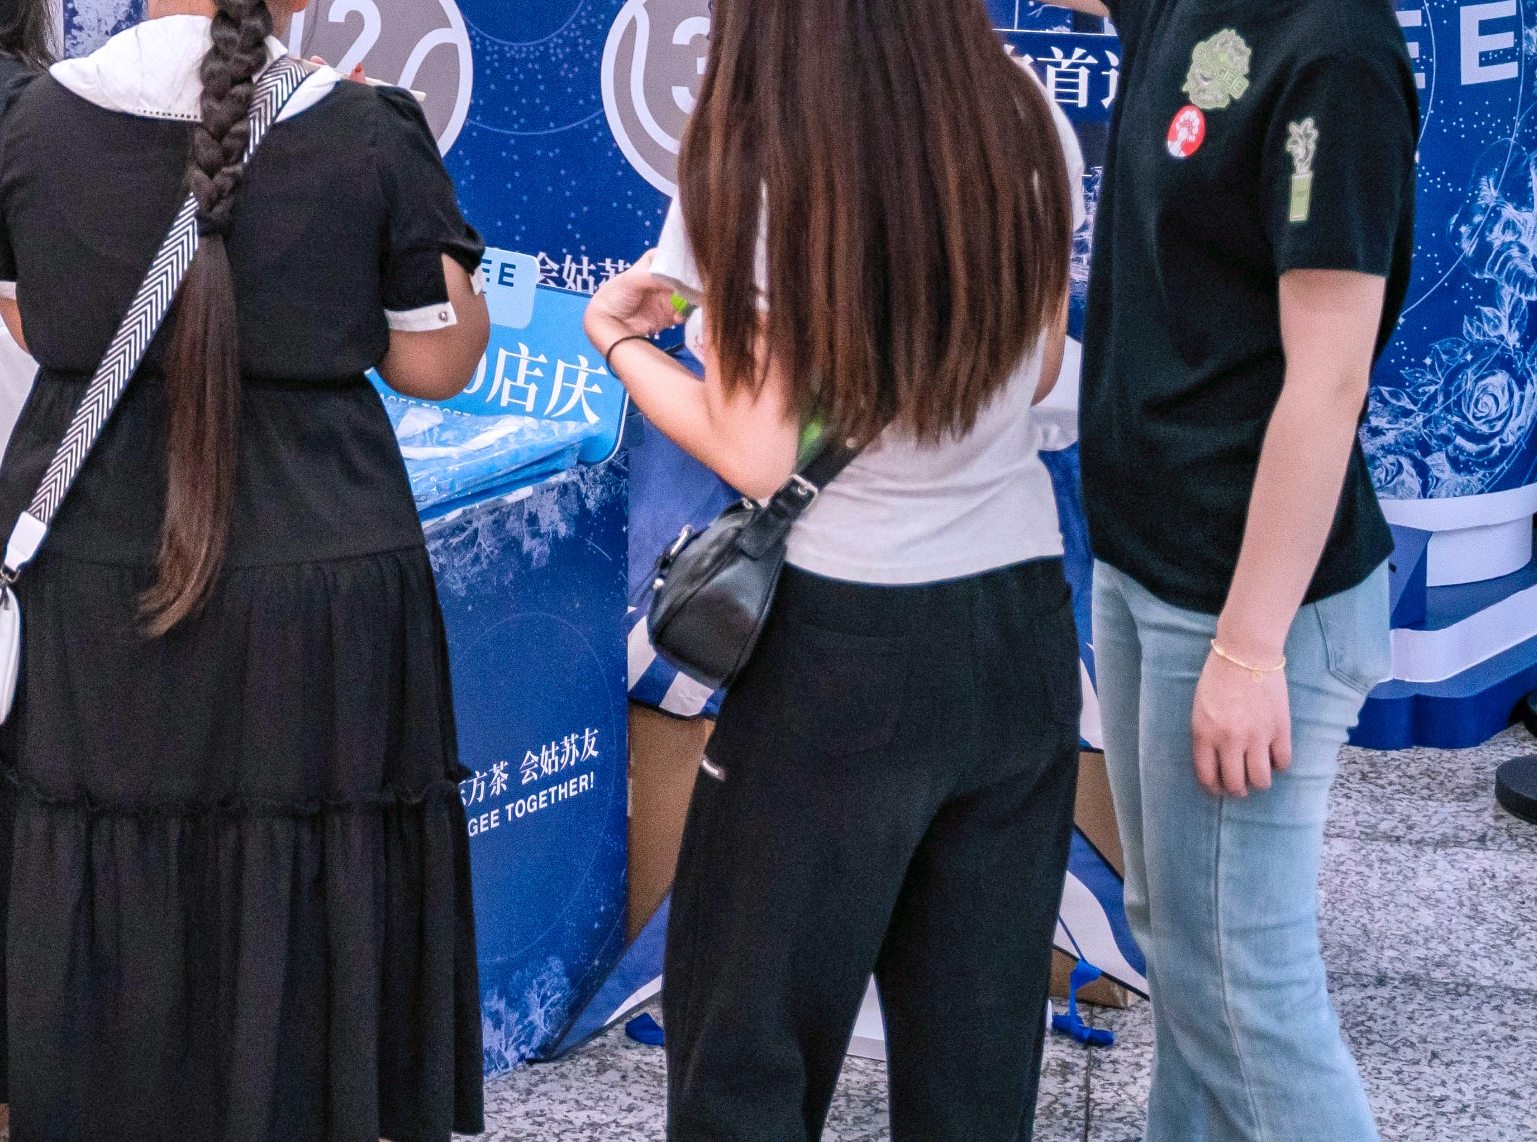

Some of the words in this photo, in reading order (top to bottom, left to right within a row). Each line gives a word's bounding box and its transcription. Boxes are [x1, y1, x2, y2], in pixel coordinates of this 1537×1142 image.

[519, 727, 599, 785] 会姑苏友
[504, 770, 595, 822] TOGETHER!
